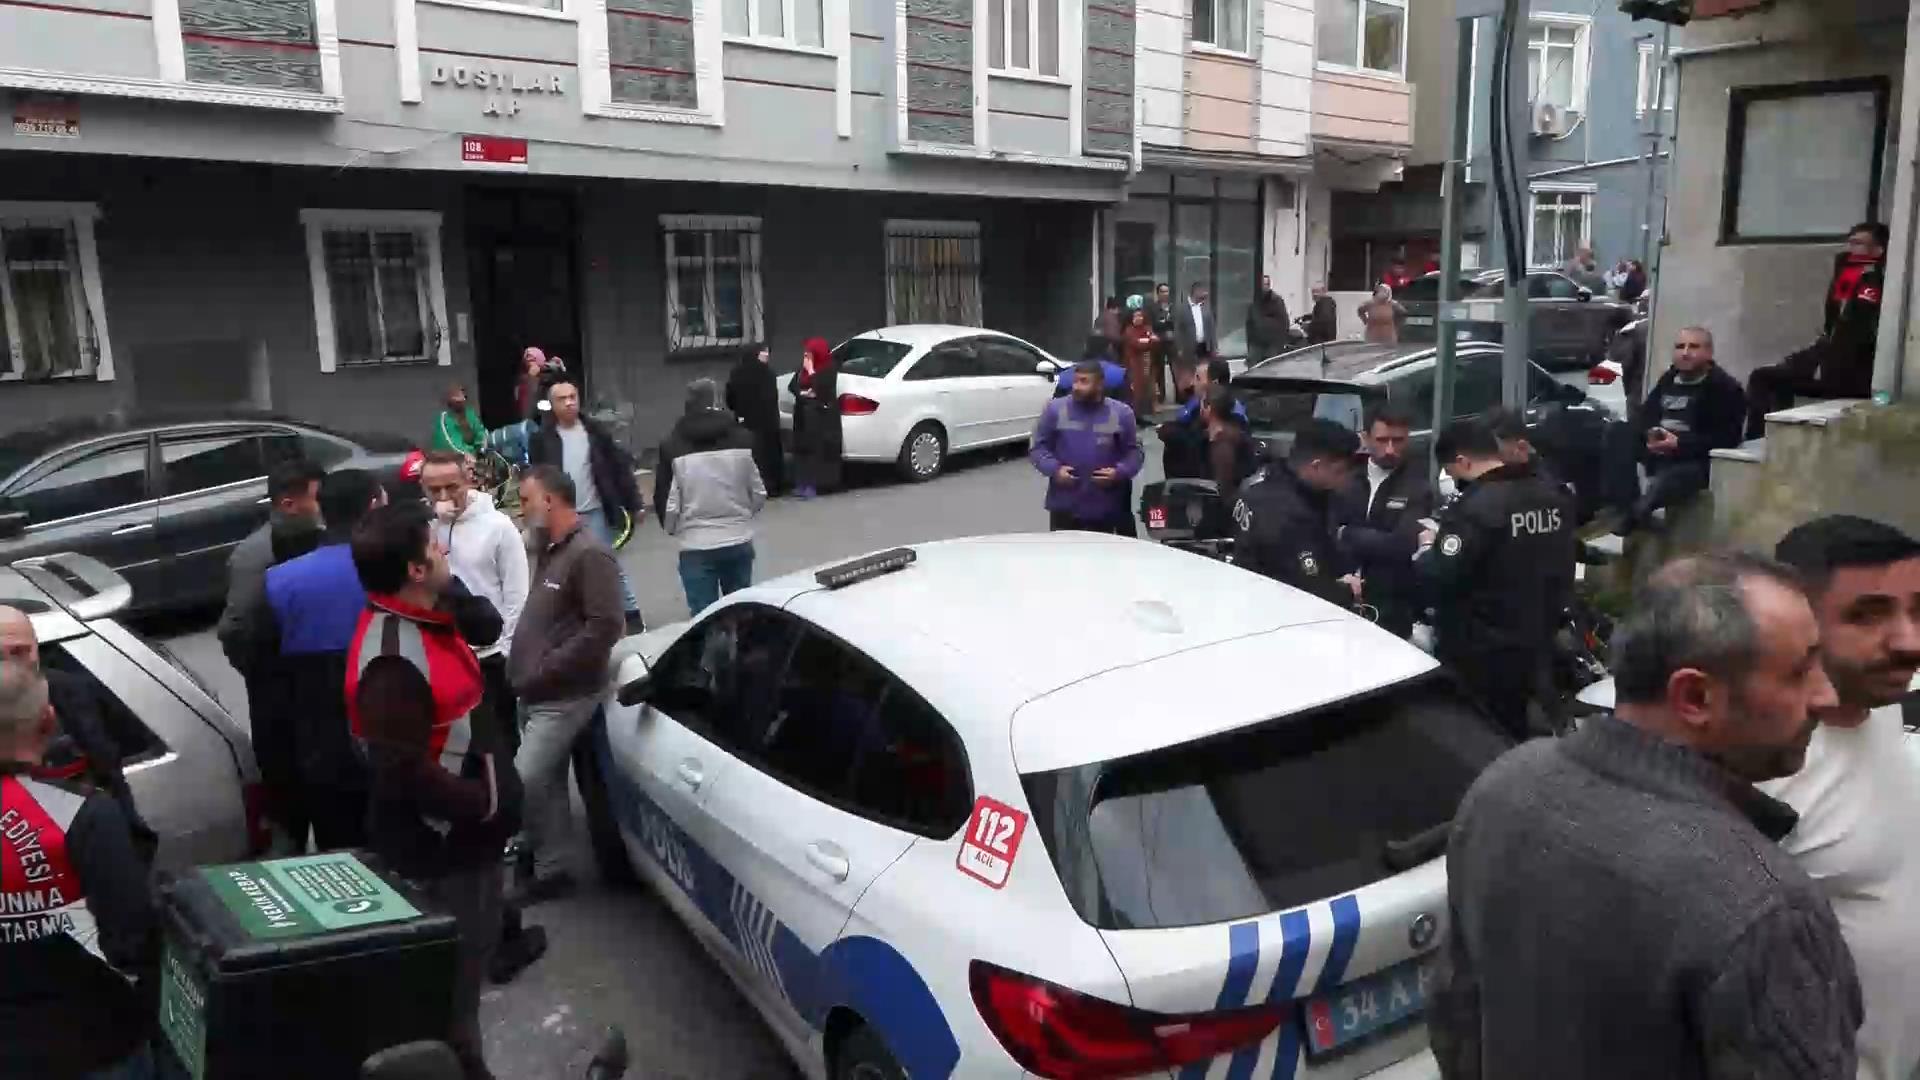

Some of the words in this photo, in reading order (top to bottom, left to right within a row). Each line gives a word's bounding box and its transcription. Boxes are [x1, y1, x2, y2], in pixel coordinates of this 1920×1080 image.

[431, 66, 563, 94] DOSTLAR
[1150, 508, 1163, 520] 112
[976, 807, 1015, 854] 112
[0, 912, 75, 944] TARMA
[1342, 991, 1377, 1031] 34
